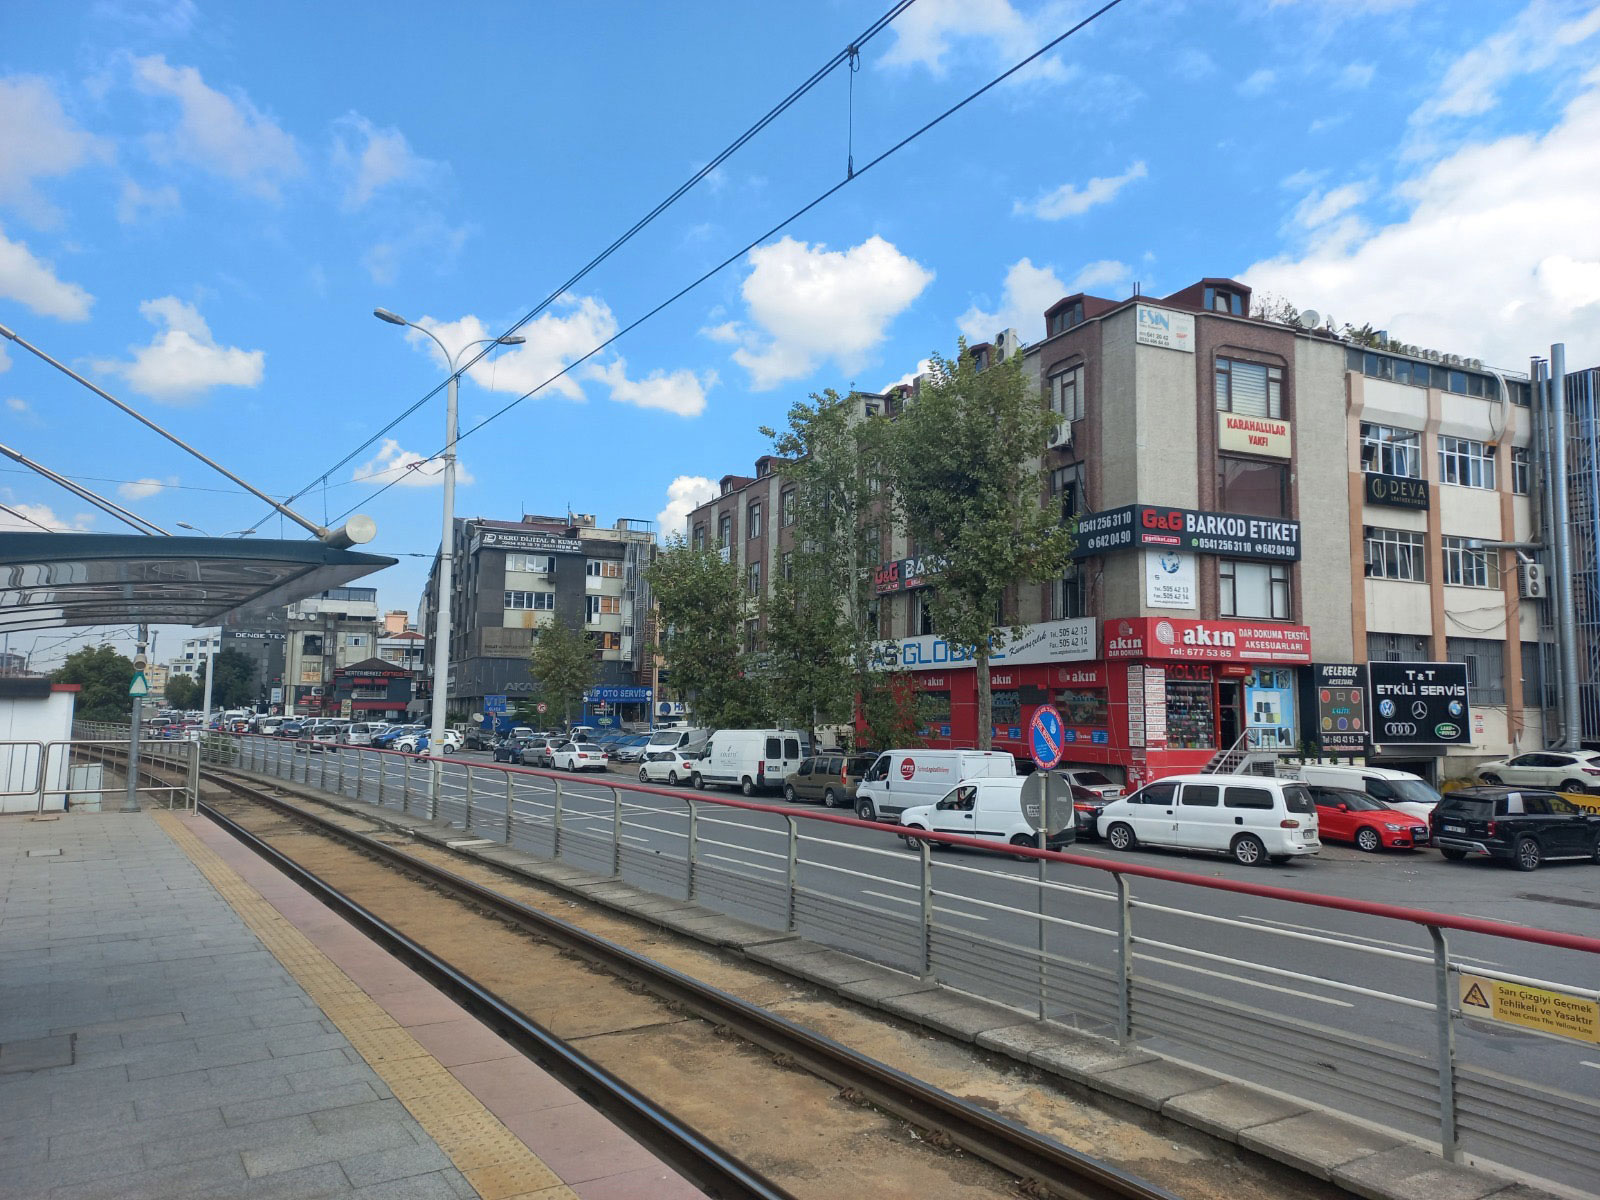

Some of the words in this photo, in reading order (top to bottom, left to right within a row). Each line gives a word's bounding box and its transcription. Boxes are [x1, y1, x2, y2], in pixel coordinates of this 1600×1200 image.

[1227, 418, 1286, 436] KARAHALLILAR
[1248, 435, 1268, 446] VAKFI
[1390, 480, 1426, 498] DEVA
[1080, 519, 1096, 534] 0541
[1097, 516, 1111, 529] 256
[1113, 514, 1121, 526] 31
[1122, 512, 1131, 524] 10
[1142, 509, 1183, 531] G&G
[1186, 513, 1246, 537] BARKOD
[1096, 534, 1109, 548] 642
[1110, 532, 1120, 546] 04
[1121, 530, 1131, 543] 90
[1199, 538, 1218, 549] 0541
[1218, 539, 1233, 551] 256
[1234, 541, 1242, 552] 31
[1243, 542, 1251, 553] 10
[1263, 544, 1276, 554] 642
[1276, 545, 1285, 555] 04
[1286, 546, 1295, 556] 90
[1059, 628, 1070, 637] 505
[1071, 627, 1078, 636] 42
[1081, 626, 1088, 635] 13
[1184, 625, 1236, 647] akın
[1239, 629, 1252, 638] DAR
[1254, 630, 1283, 639] DOKUMA
[1059, 639, 1070, 648] 505
[1071, 638, 1078, 647] 42
[1081, 637, 1088, 646] 14
[1110, 637, 1142, 649] akın
[1245, 641, 1302, 651] AKSESUARLARI
[1109, 649, 1120, 657] DAR
[1121, 648, 1143, 656] DOKUMA
[1170, 648, 1184, 656] Tel:
[1187, 648, 1204, 656] 677
[1072, 672, 1096, 682] akın
[1165, 664, 1210, 680] KOLYE
[1322, 666, 1358, 677] KELEBEK
[1406, 670, 1416, 680] T
[1425, 670, 1435, 680] T
[928, 678, 944, 687] akın
[992, 676, 1012, 685] akın
[602, 690, 618, 698] OTO
[620, 689, 646, 698] SERVİS
[1376, 683, 1416, 695] ETKİLİ
[1420, 684, 1465, 696] SERVİS
[1498, 986, 1516, 997] Sarı
[1519, 991, 1551, 1006] Çizgiyi
[1553, 998, 1592, 1014] Geçmek
[1499, 998, 1538, 1013] Tehlikeli
[1540, 1006, 1552, 1015] ve
[1554, 1010, 1592, 1026] Yasaktır
[1510, 1010, 1522, 1018] Not
[1523, 1014, 1540, 1022] Cross
[1542, 1017, 1554, 1026] The
[1556, 1020, 1577, 1031] Yellow
[1578, 1025, 1592, 1034] Line
